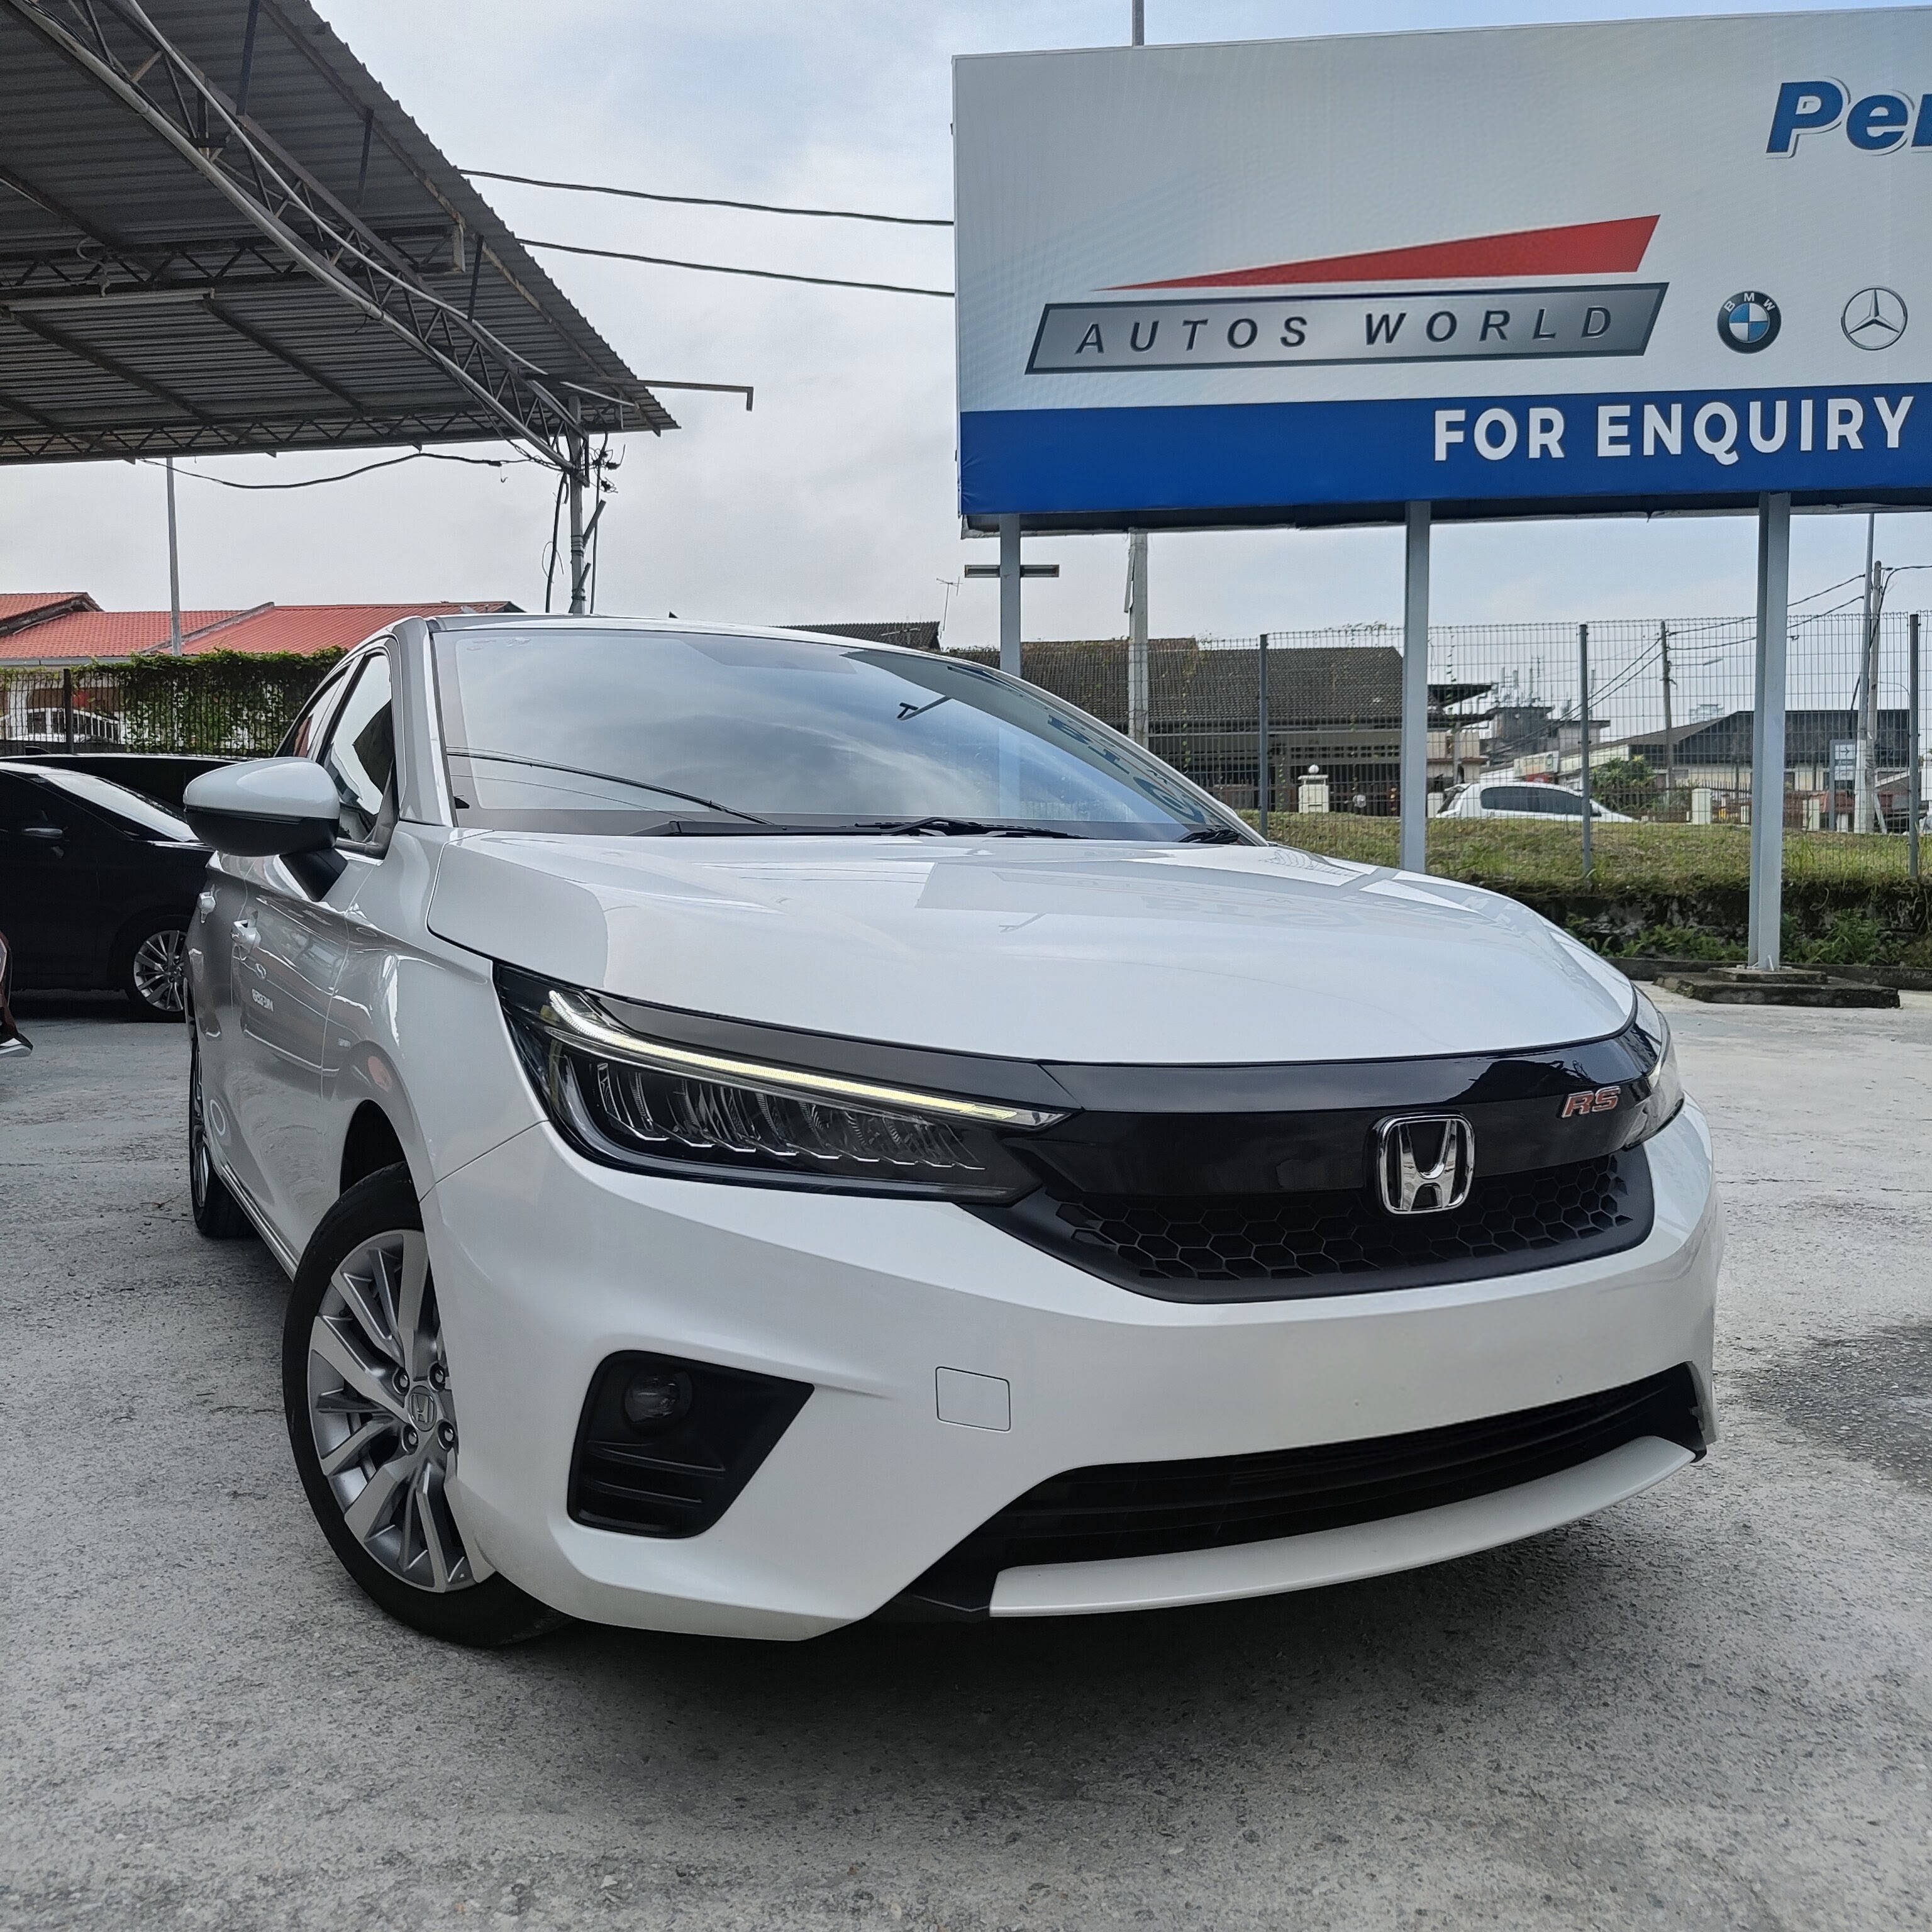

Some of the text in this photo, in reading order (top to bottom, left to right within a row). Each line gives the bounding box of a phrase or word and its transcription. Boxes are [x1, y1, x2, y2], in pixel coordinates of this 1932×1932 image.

[1724, 292, 1775, 313] BMW
[1075, 306, 1612, 355] AUTOS WORLD
[1434, 396, 1914, 465] FOR ENQUIRY
[1562, 1085, 1621, 1118] RS
